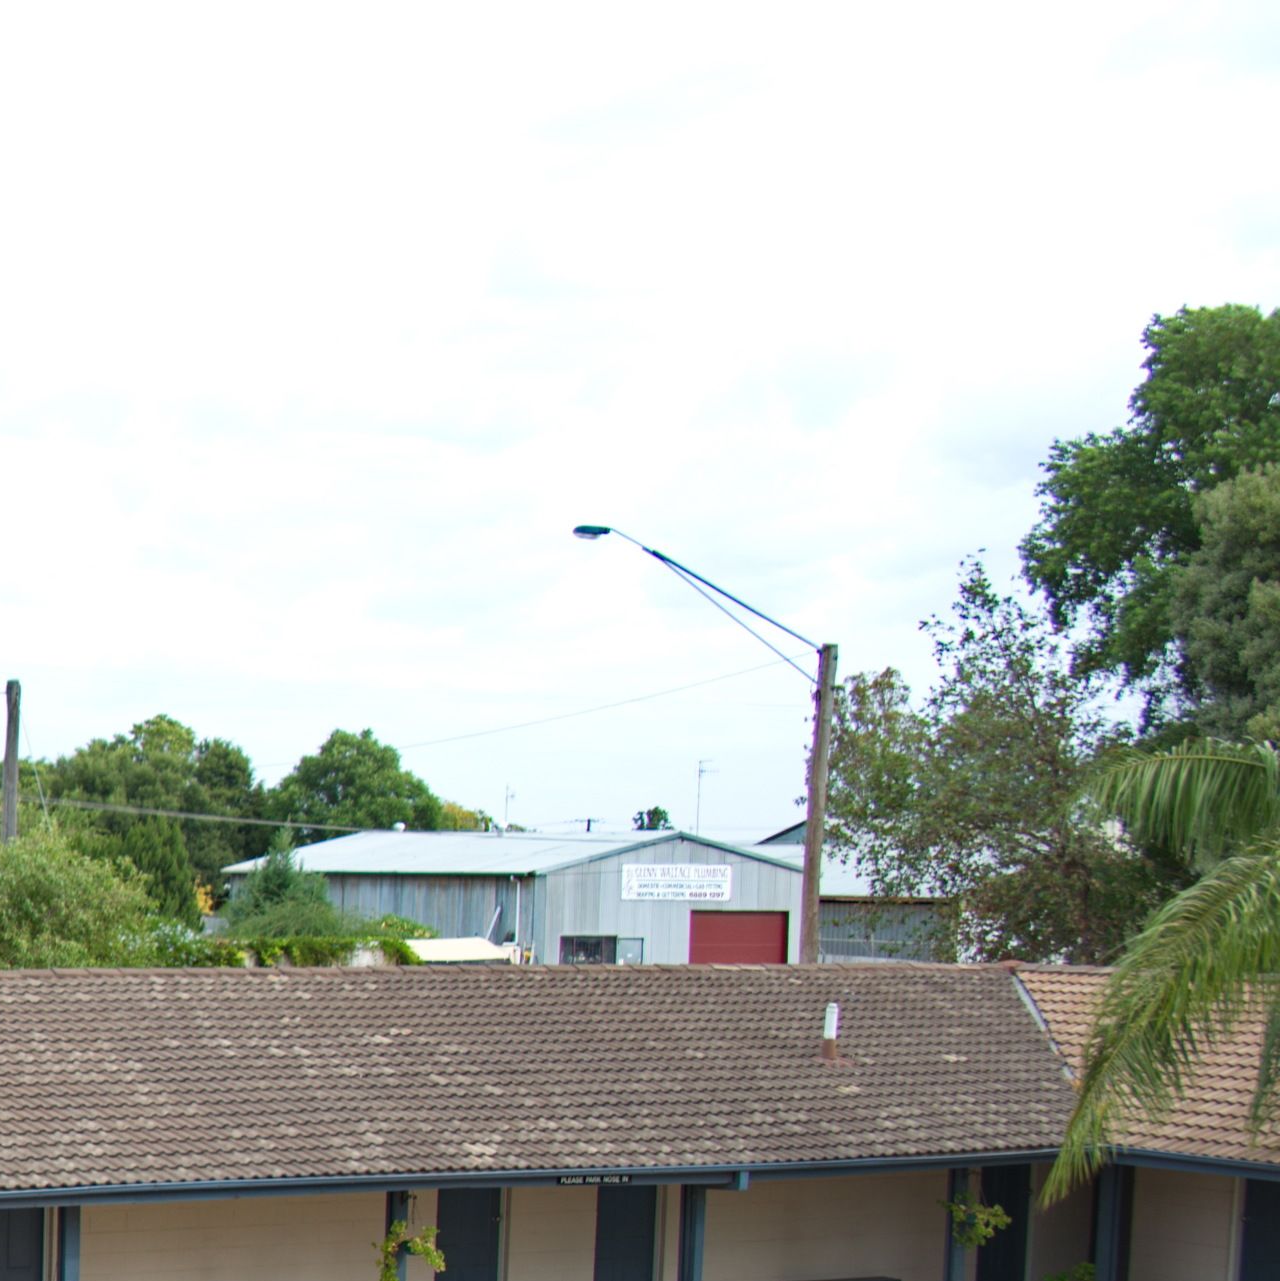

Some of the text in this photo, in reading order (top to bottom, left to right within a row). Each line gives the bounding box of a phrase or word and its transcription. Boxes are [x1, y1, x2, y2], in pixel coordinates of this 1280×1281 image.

[694, 867, 728, 879] PLUMBING
[560, 1175, 629, 1184] PLEASE PARK NOSE IN
